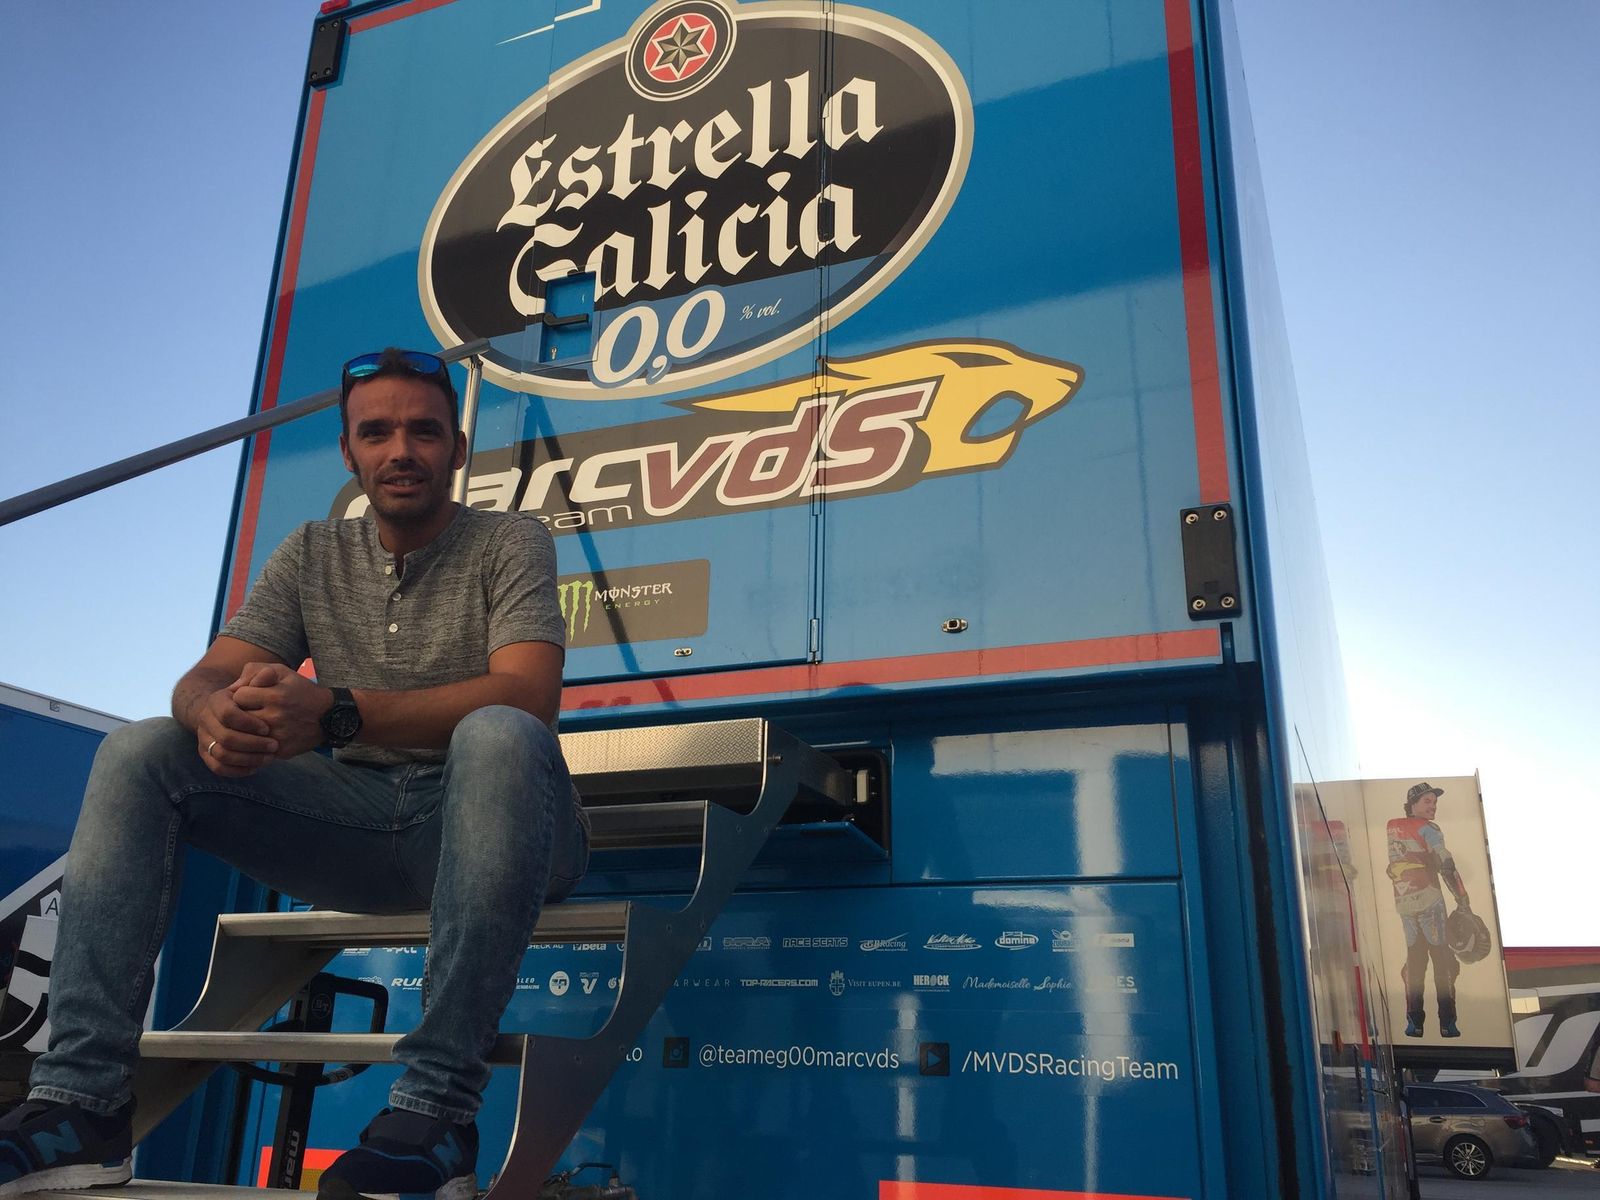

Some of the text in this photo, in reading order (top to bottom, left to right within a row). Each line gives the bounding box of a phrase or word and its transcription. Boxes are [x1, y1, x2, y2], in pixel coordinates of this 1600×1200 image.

[496, 71, 884, 233] Estrella
[509, 171, 862, 315] Galicia
[757, 297, 783, 319] vol.
[605, 599, 661, 610] ENERGY
[913, 974, 950, 987] HEROCK
[962, 975, 1031, 990] Mademoiselle
[699, 1043, 900, 1069] @teameg00marcvds
[961, 1050, 1179, 1081] /MVDSRacingTeam
